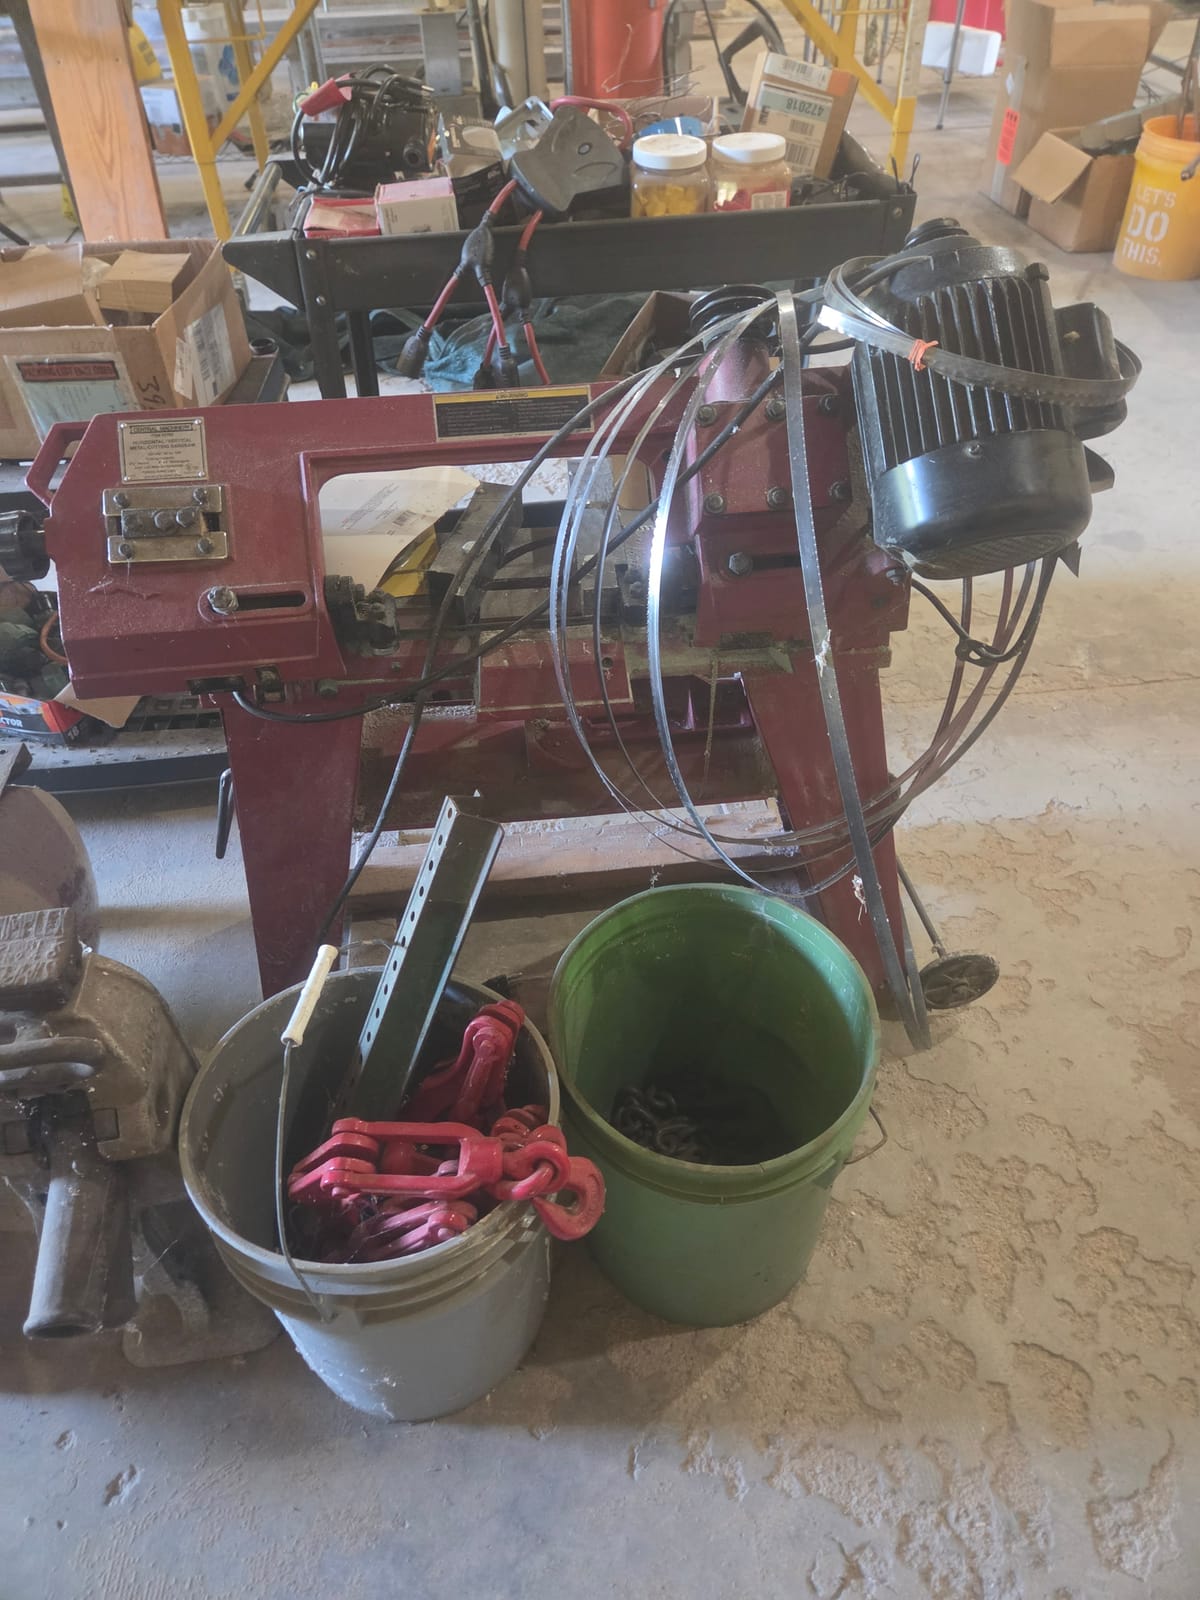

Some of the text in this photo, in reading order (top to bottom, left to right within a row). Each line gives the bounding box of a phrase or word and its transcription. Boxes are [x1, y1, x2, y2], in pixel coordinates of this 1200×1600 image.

[785, 97, 824, 117] 472018
[1135, 184, 1177, 208] LET'S
[1127, 203, 1169, 242] DO
